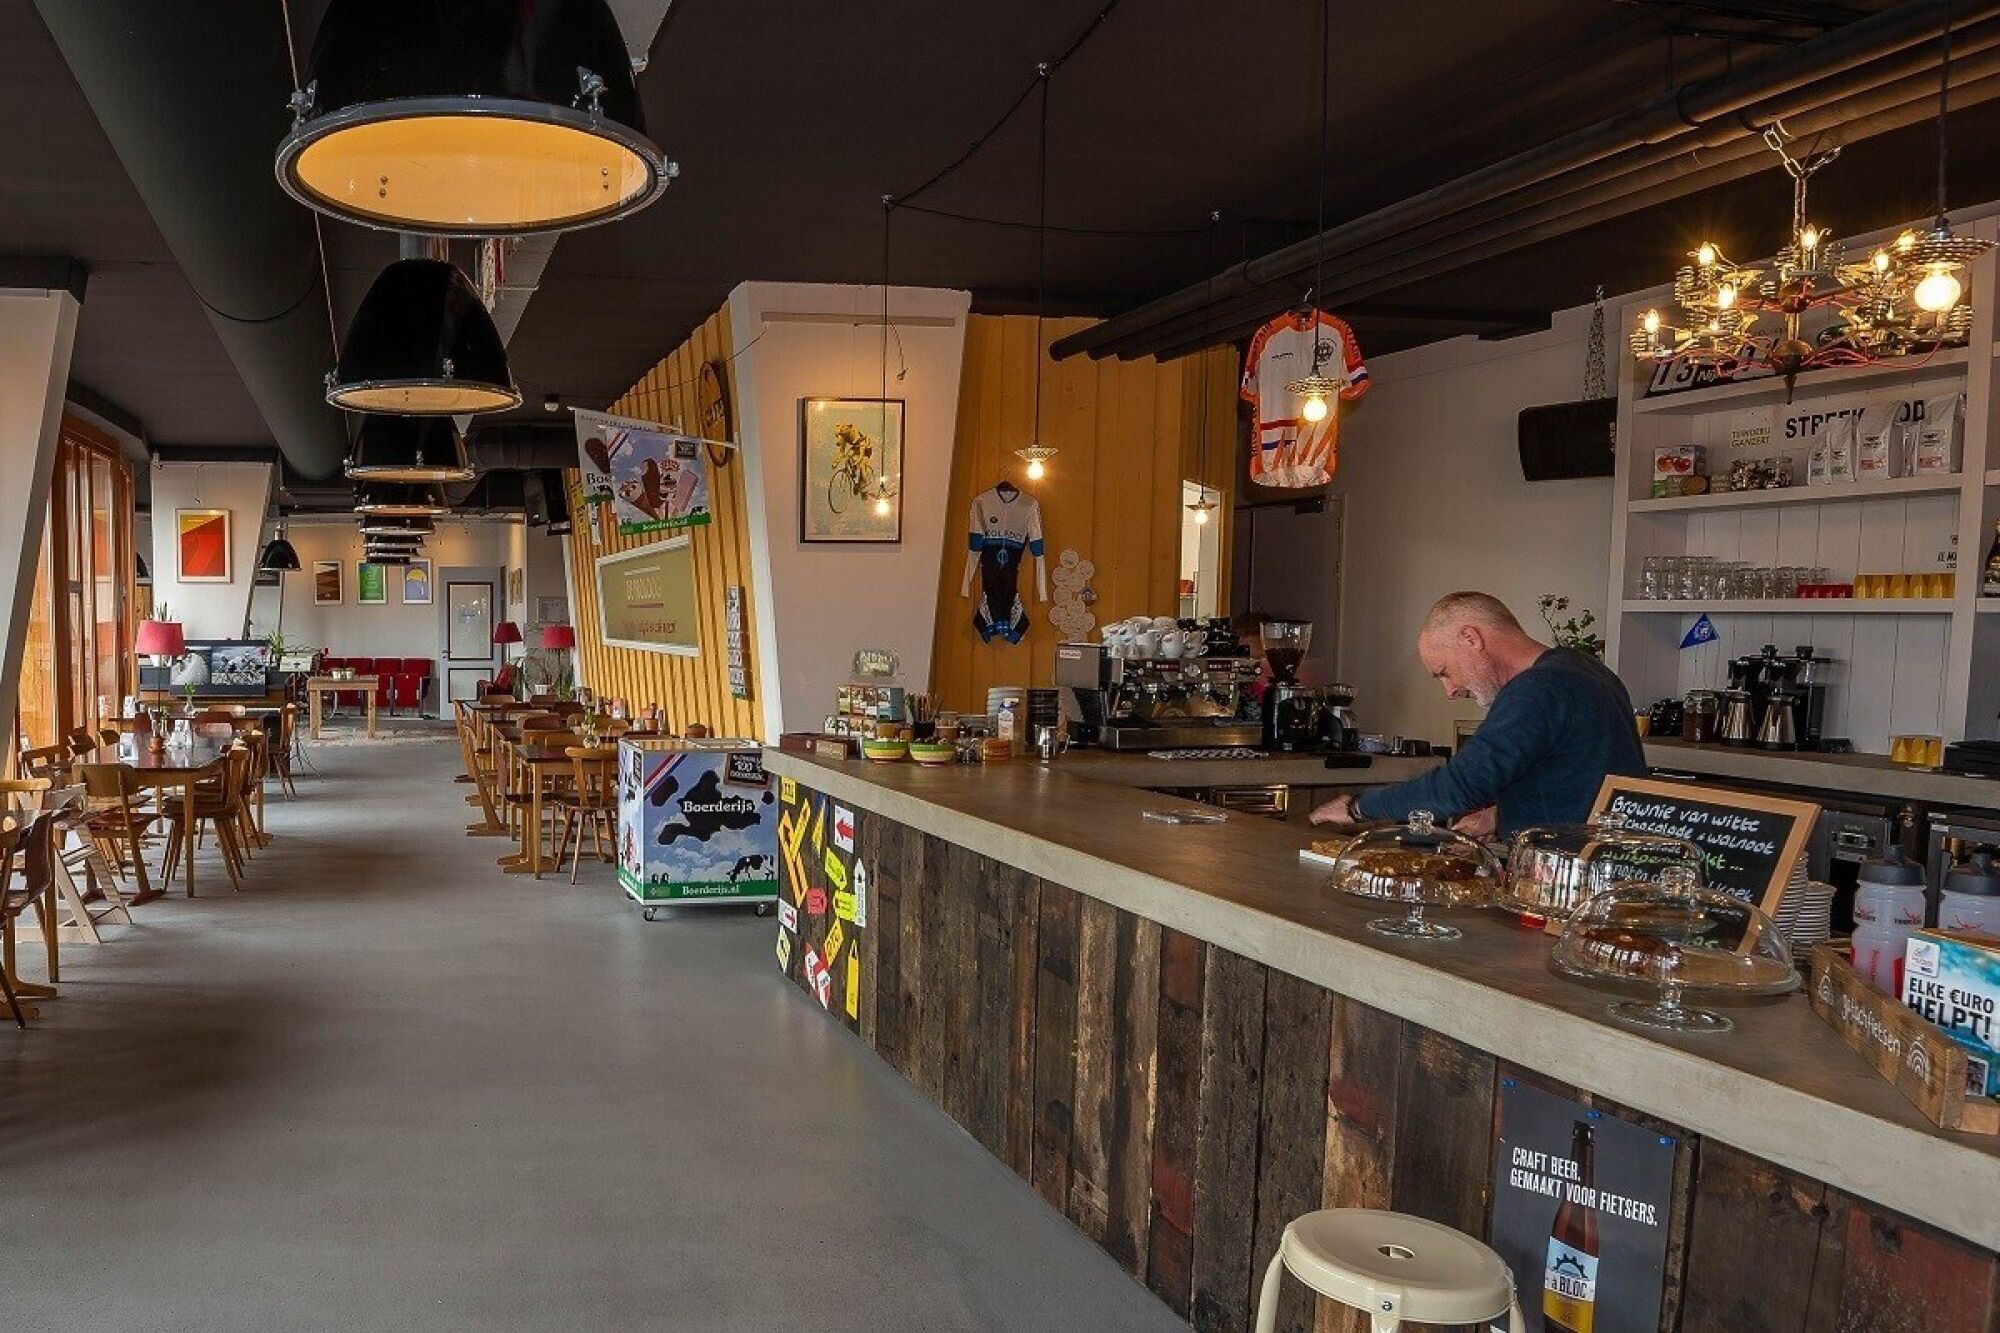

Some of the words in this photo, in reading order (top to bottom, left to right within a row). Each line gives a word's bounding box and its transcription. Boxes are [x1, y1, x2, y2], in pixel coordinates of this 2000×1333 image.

[683, 800, 753, 813] Boerderijs
[1611, 795, 1676, 821] Brownie
[1680, 809, 1708, 827] van
[1711, 815, 1760, 833] witte
[1909, 977, 1945, 1001] ELKE
[1907, 993, 1991, 1041] HELPT!
[1512, 1147, 1548, 1172] CRAFT
[1551, 1155, 1581, 1182] BEER.
[1510, 1167, 1563, 1199] GEMAAKT
[1566, 1182, 1596, 1208] VOOR
[1600, 1192, 1658, 1227] FIETSERS.
